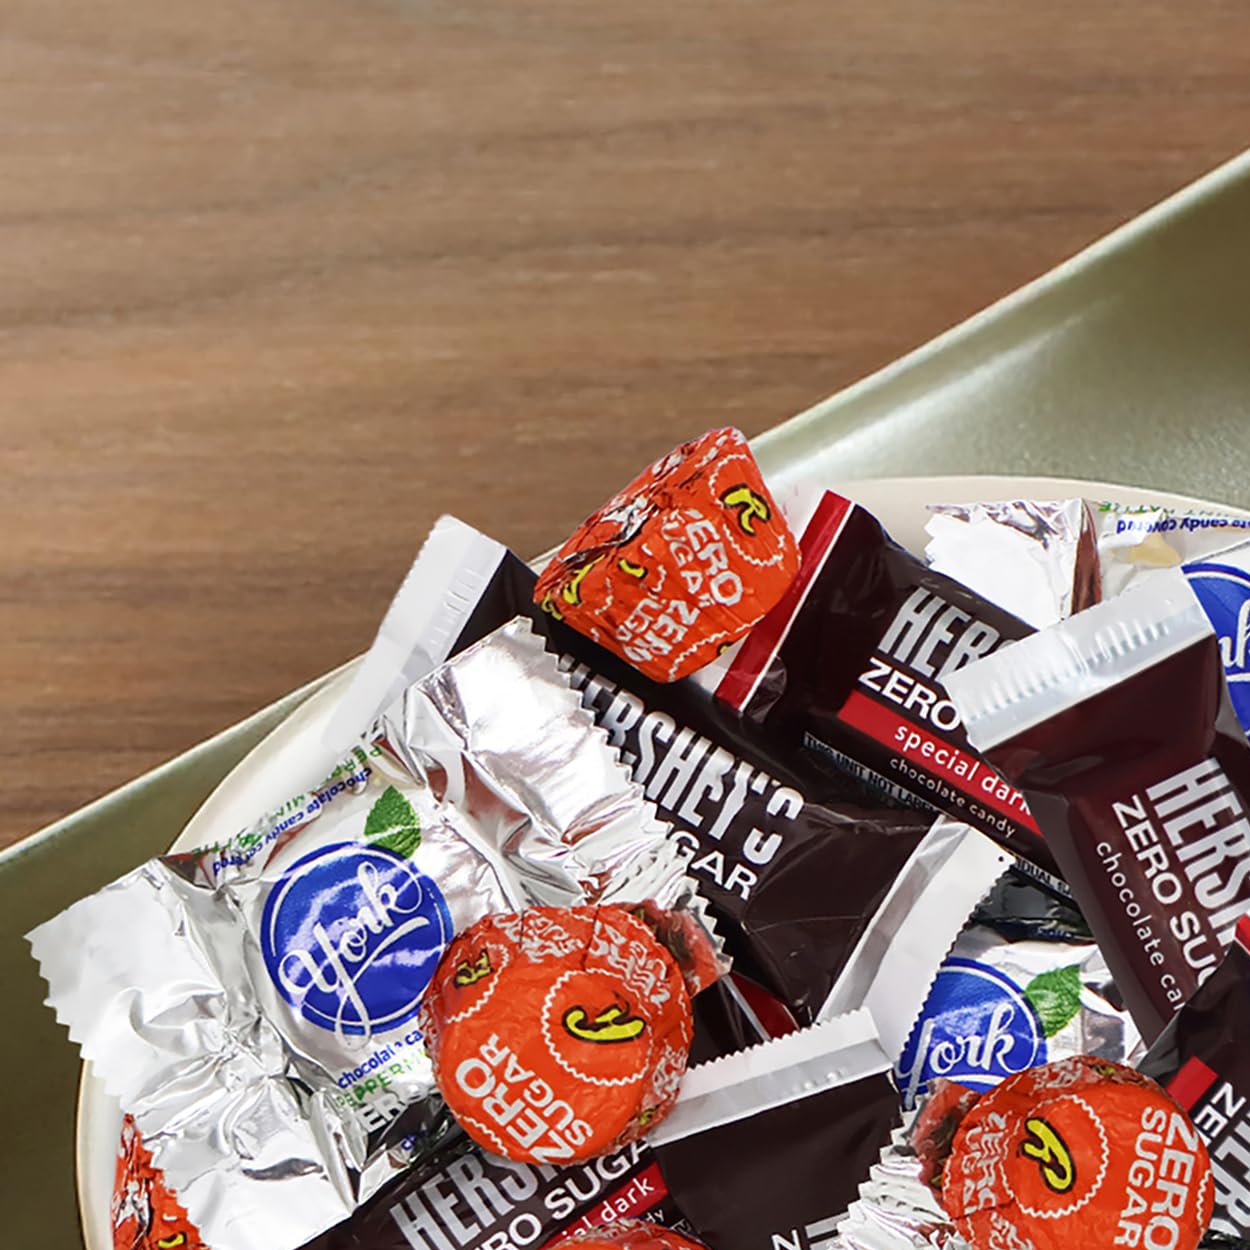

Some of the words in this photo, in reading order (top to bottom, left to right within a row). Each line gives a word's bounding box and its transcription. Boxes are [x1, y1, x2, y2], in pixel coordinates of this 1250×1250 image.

[684, 508, 743, 606] ERO
[878, 587, 1016, 683] HER
[858, 657, 961, 731] ZERO
[889, 757, 966, 808] chocolate
[968, 804, 1016, 839] candy
[894, 725, 980, 782] special
[1112, 794, 1183, 905] ZERO
[277, 860, 431, 1050] York
[1096, 842, 1165, 967] chocolate
[455, 1058, 576, 1164] ZERO
[479, 1033, 593, 1146] SUGAR
[601, 1176, 656, 1223] dark
[1113, 1106, 1167, 1249] SUGAR
